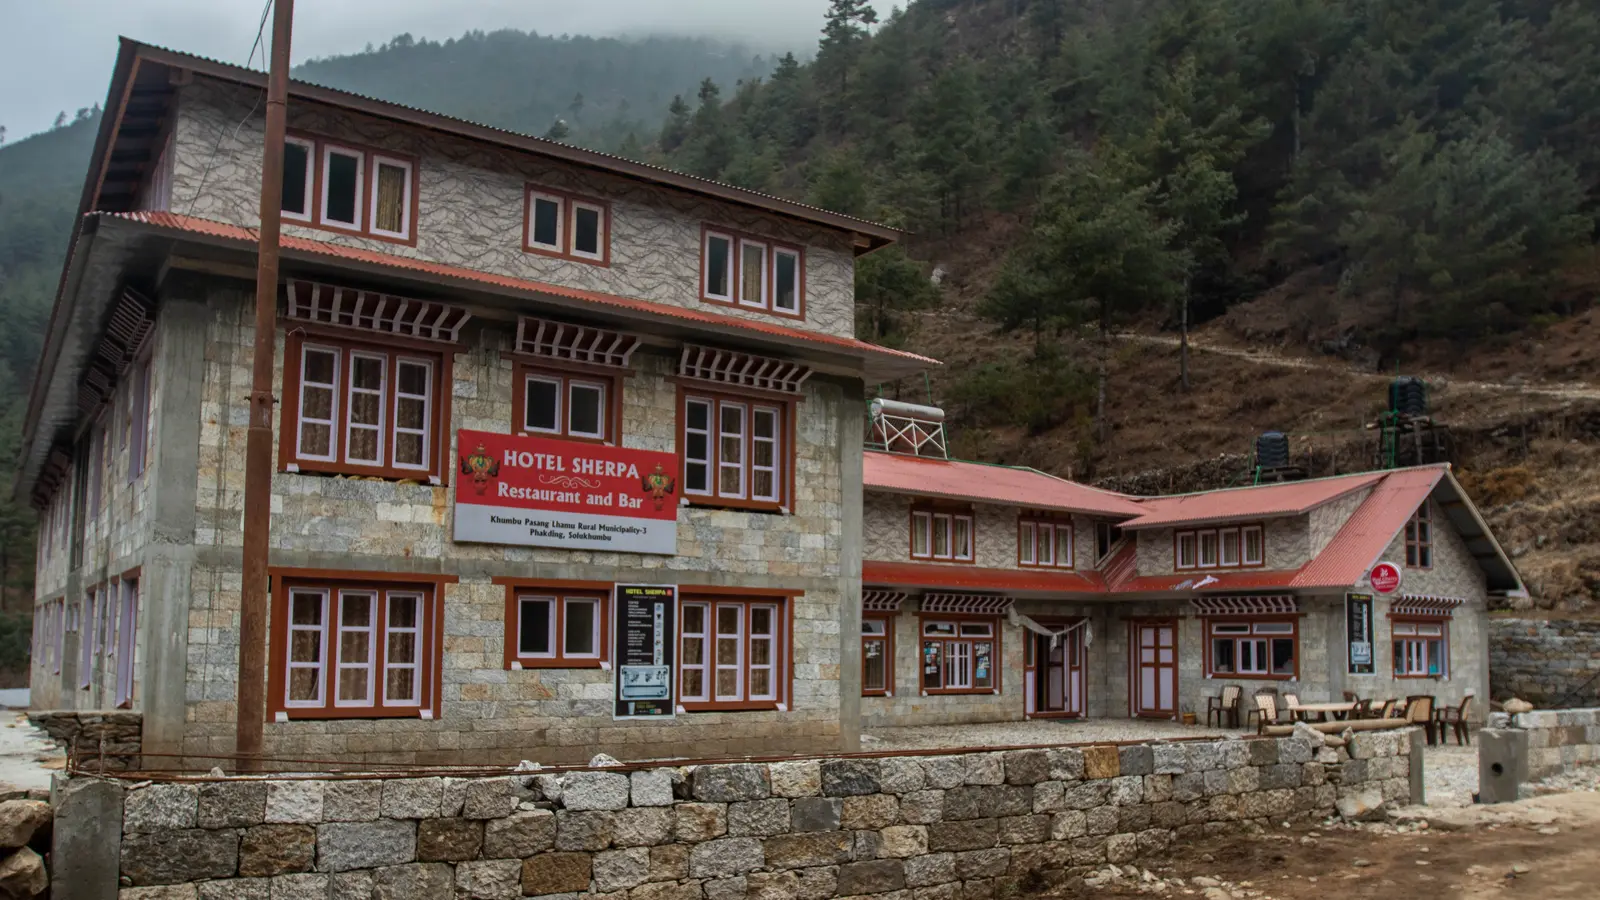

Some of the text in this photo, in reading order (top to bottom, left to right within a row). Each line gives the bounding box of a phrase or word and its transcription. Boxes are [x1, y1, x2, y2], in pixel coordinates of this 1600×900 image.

[504, 449, 640, 479] HOTEL SHERPA
[498, 482, 644, 509] Restaurant and Bar
[490, 515, 647, 536] Khumbu Pasang Lhamu Rural Municipality-3
[530, 529, 612, 542] Phakding, Solukhumbu
